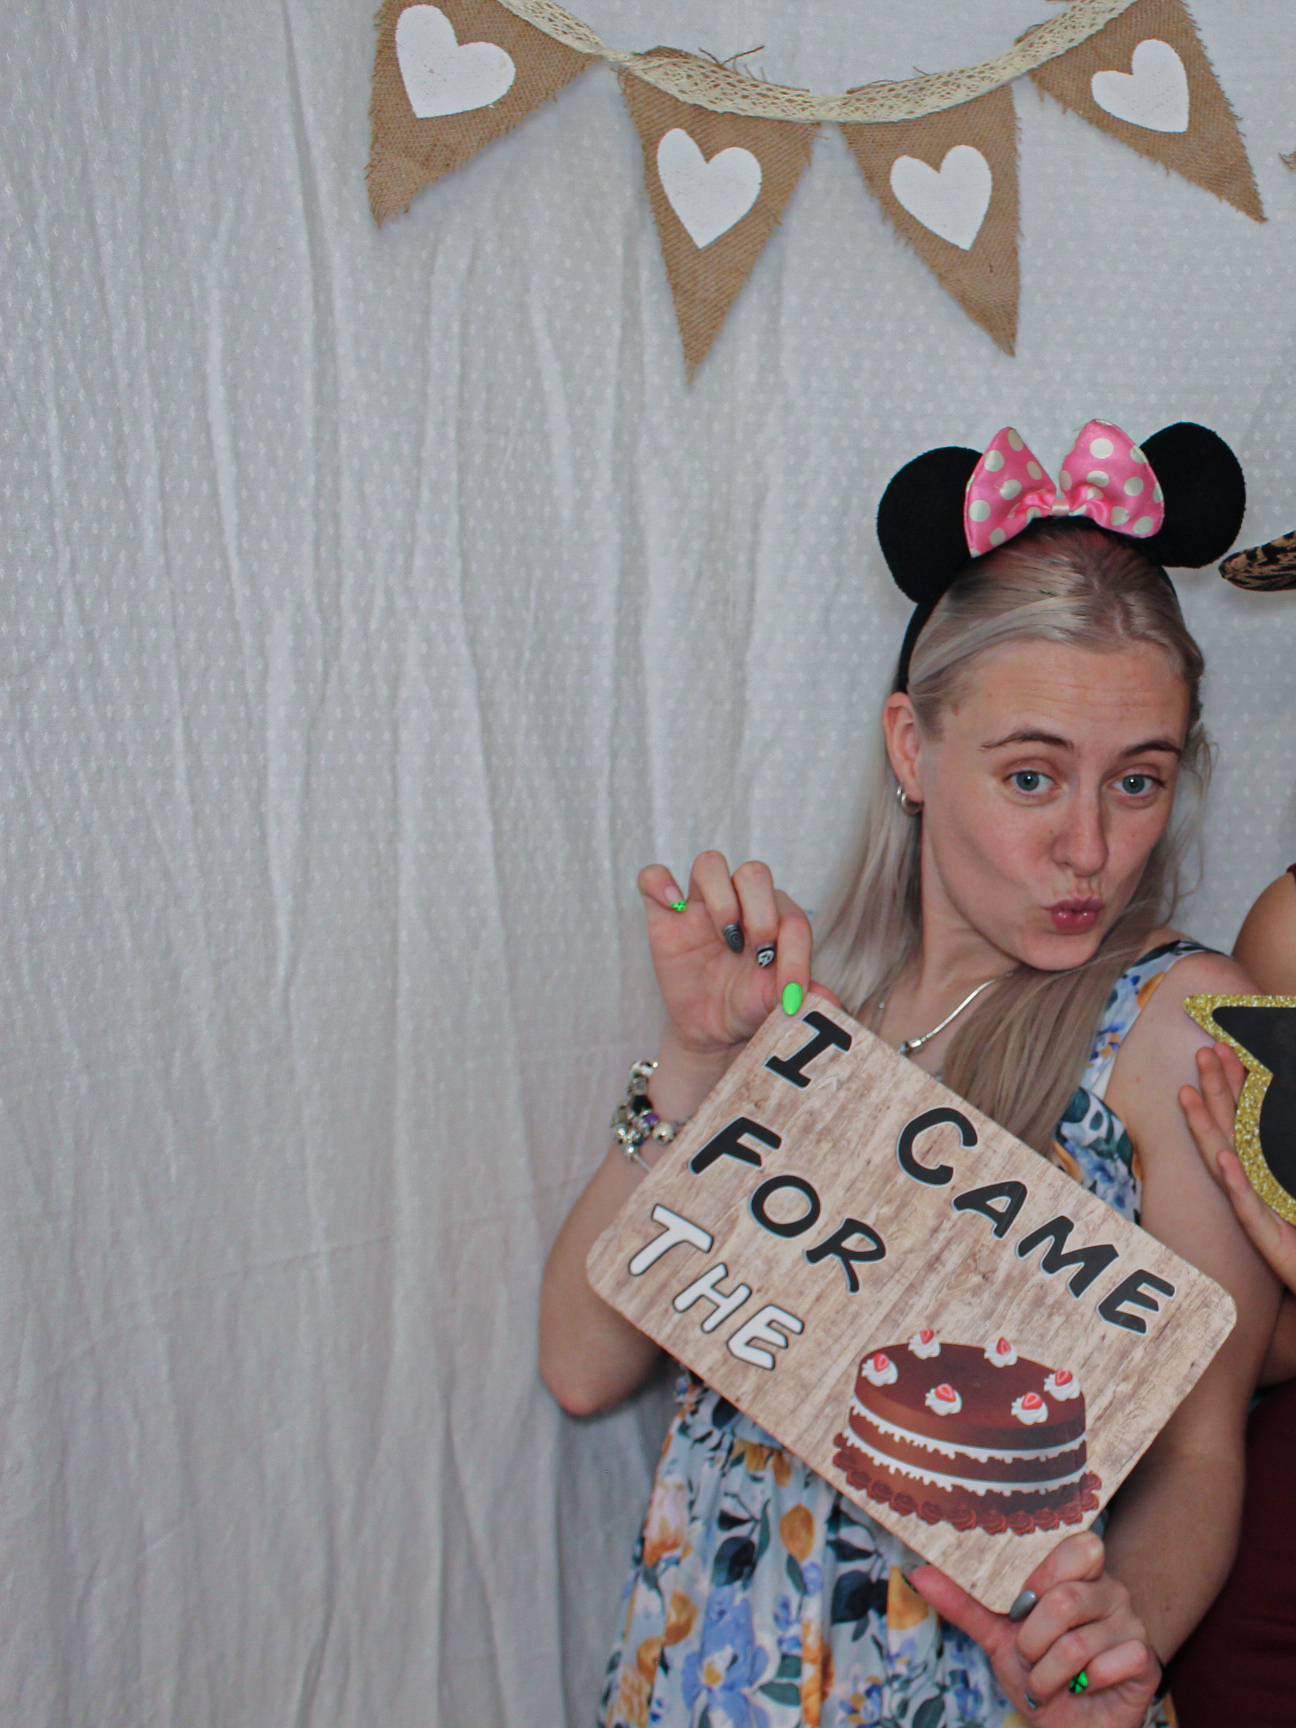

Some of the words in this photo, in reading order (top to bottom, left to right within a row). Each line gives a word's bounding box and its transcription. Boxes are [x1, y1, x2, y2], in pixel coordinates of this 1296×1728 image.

[689, 1116, 887, 1293] FOR
[765, 1010, 852, 1089] I
[896, 1106, 1176, 1335] CAME
[627, 1204, 805, 1370] THE
